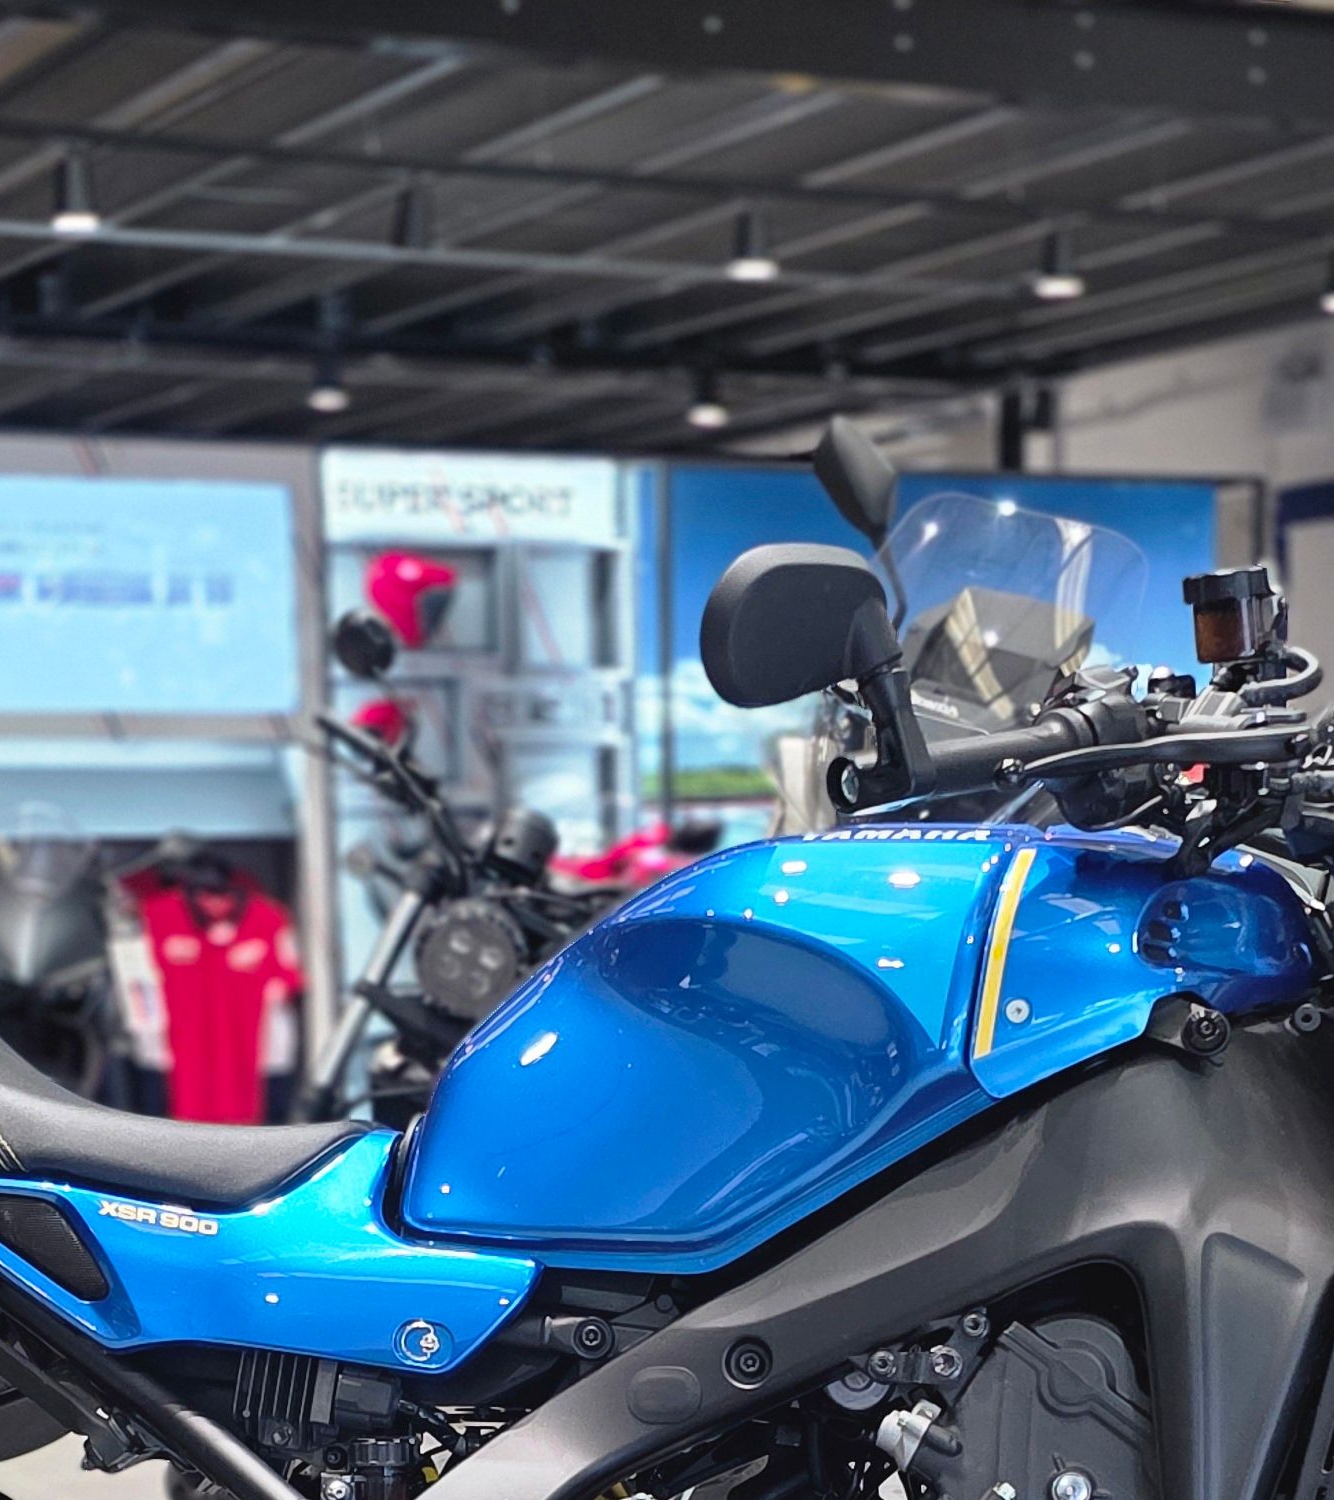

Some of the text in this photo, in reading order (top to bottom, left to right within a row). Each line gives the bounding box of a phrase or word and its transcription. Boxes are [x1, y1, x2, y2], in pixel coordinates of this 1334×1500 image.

[338, 481, 575, 518] SUPER SPORT
[802, 828, 991, 842] YAMAHA
[97, 1199, 220, 1236] XSR 900
